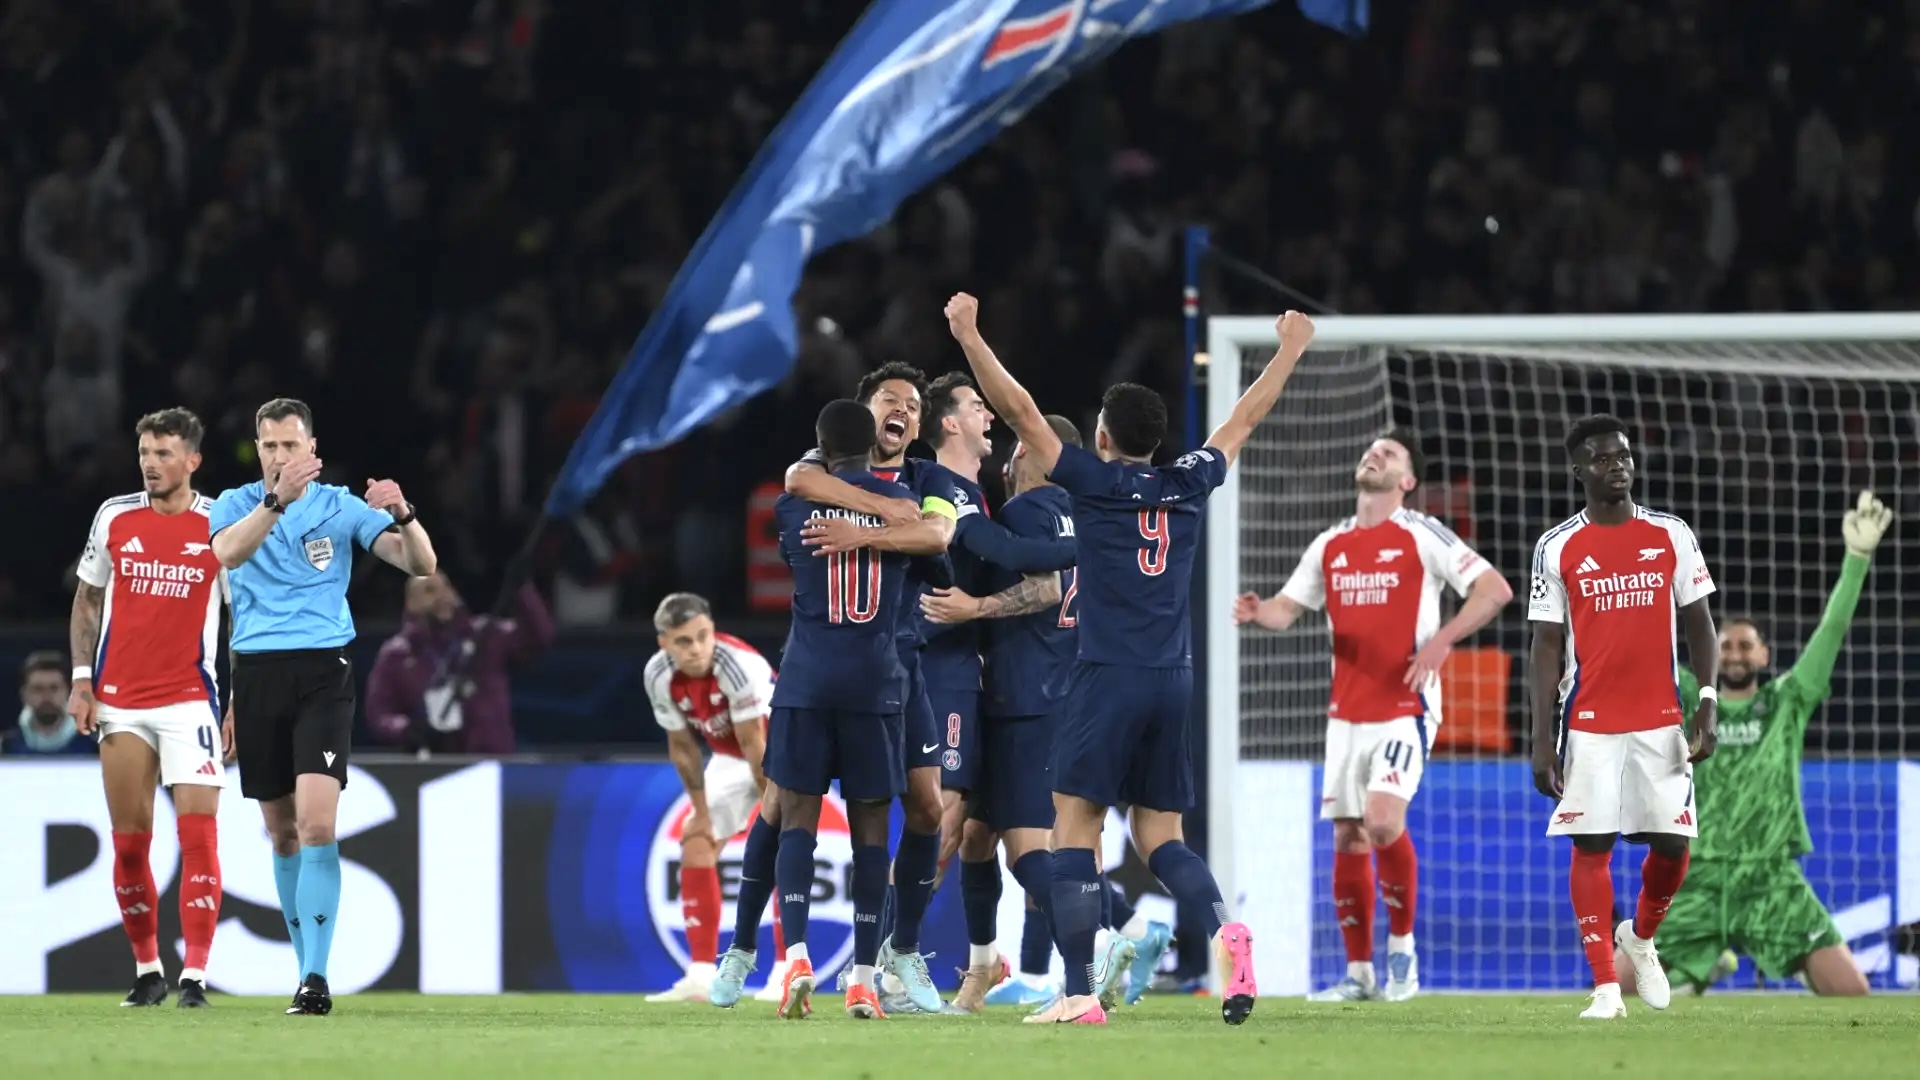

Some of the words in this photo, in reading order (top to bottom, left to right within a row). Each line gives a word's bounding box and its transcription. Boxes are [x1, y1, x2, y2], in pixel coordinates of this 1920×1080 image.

[1137, 506, 1170, 576] 9
[120, 556, 206, 583] Emirates
[1331, 569, 1400, 591] Emirates
[130, 578, 149, 594] FLY
[150, 581, 191, 599] BETTER
[827, 547, 881, 624] 10
[1578, 571, 1664, 597] Emirates
[1594, 594, 1612, 612] FLY
[1615, 590, 1654, 609] BETTER
[197, 725, 215, 758] 4
[947, 712, 961, 748] 8
[1384, 740, 1413, 773] 41
[190, 874, 217, 885] AFC
[785, 892, 805, 904] PARIS
